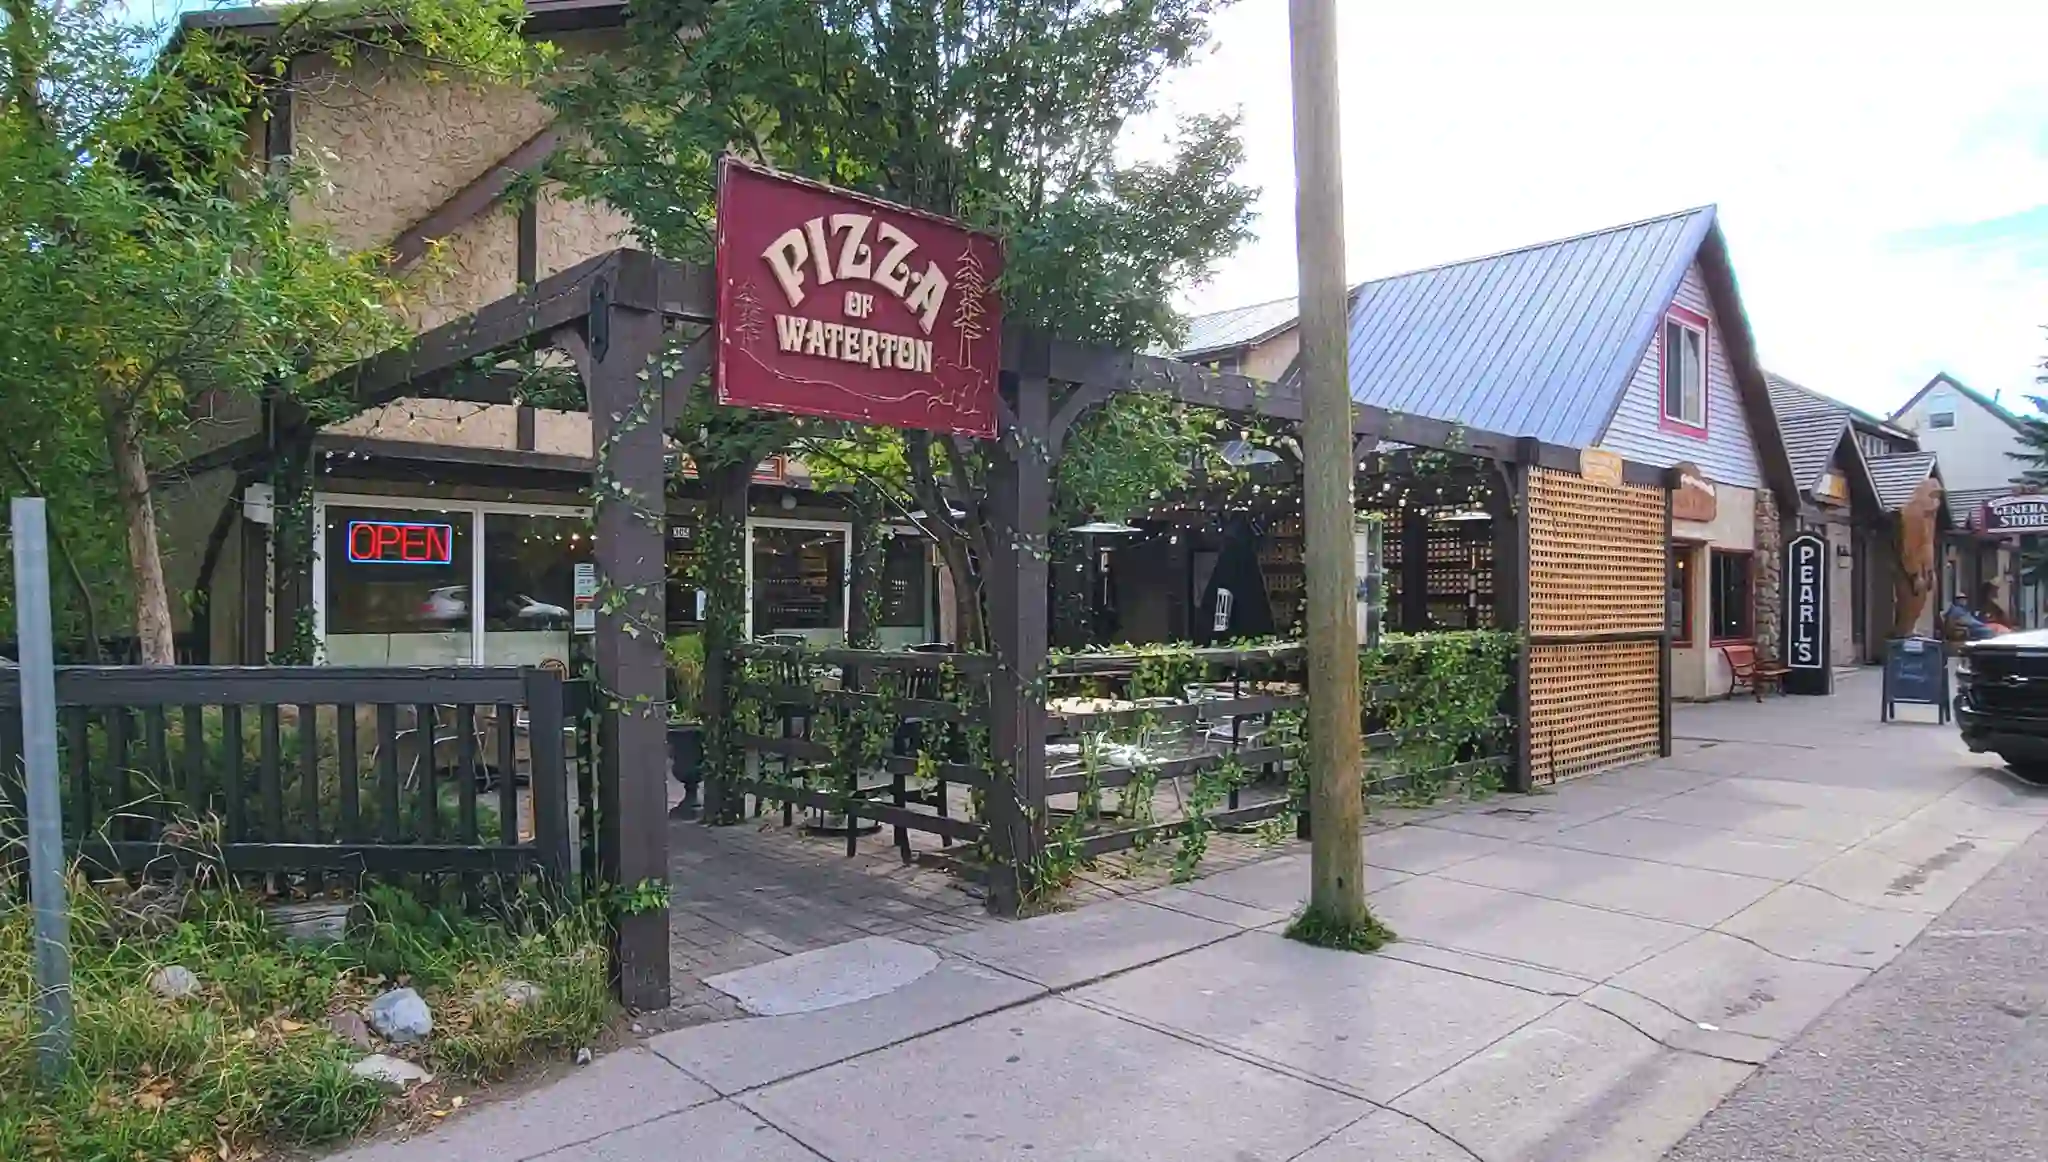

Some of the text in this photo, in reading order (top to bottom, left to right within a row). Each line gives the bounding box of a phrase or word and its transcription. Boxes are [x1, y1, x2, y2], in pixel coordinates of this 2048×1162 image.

[761, 213, 949, 335] PIZZA
[844, 290, 875, 319] OF
[774, 314, 933, 373] WATERTON
[1993, 504, 2048, 516] GENERA
[2000, 514, 2048, 527] STORE
[351, 524, 450, 561] OPEN
[1793, 546, 1815, 662] PEARL'S
